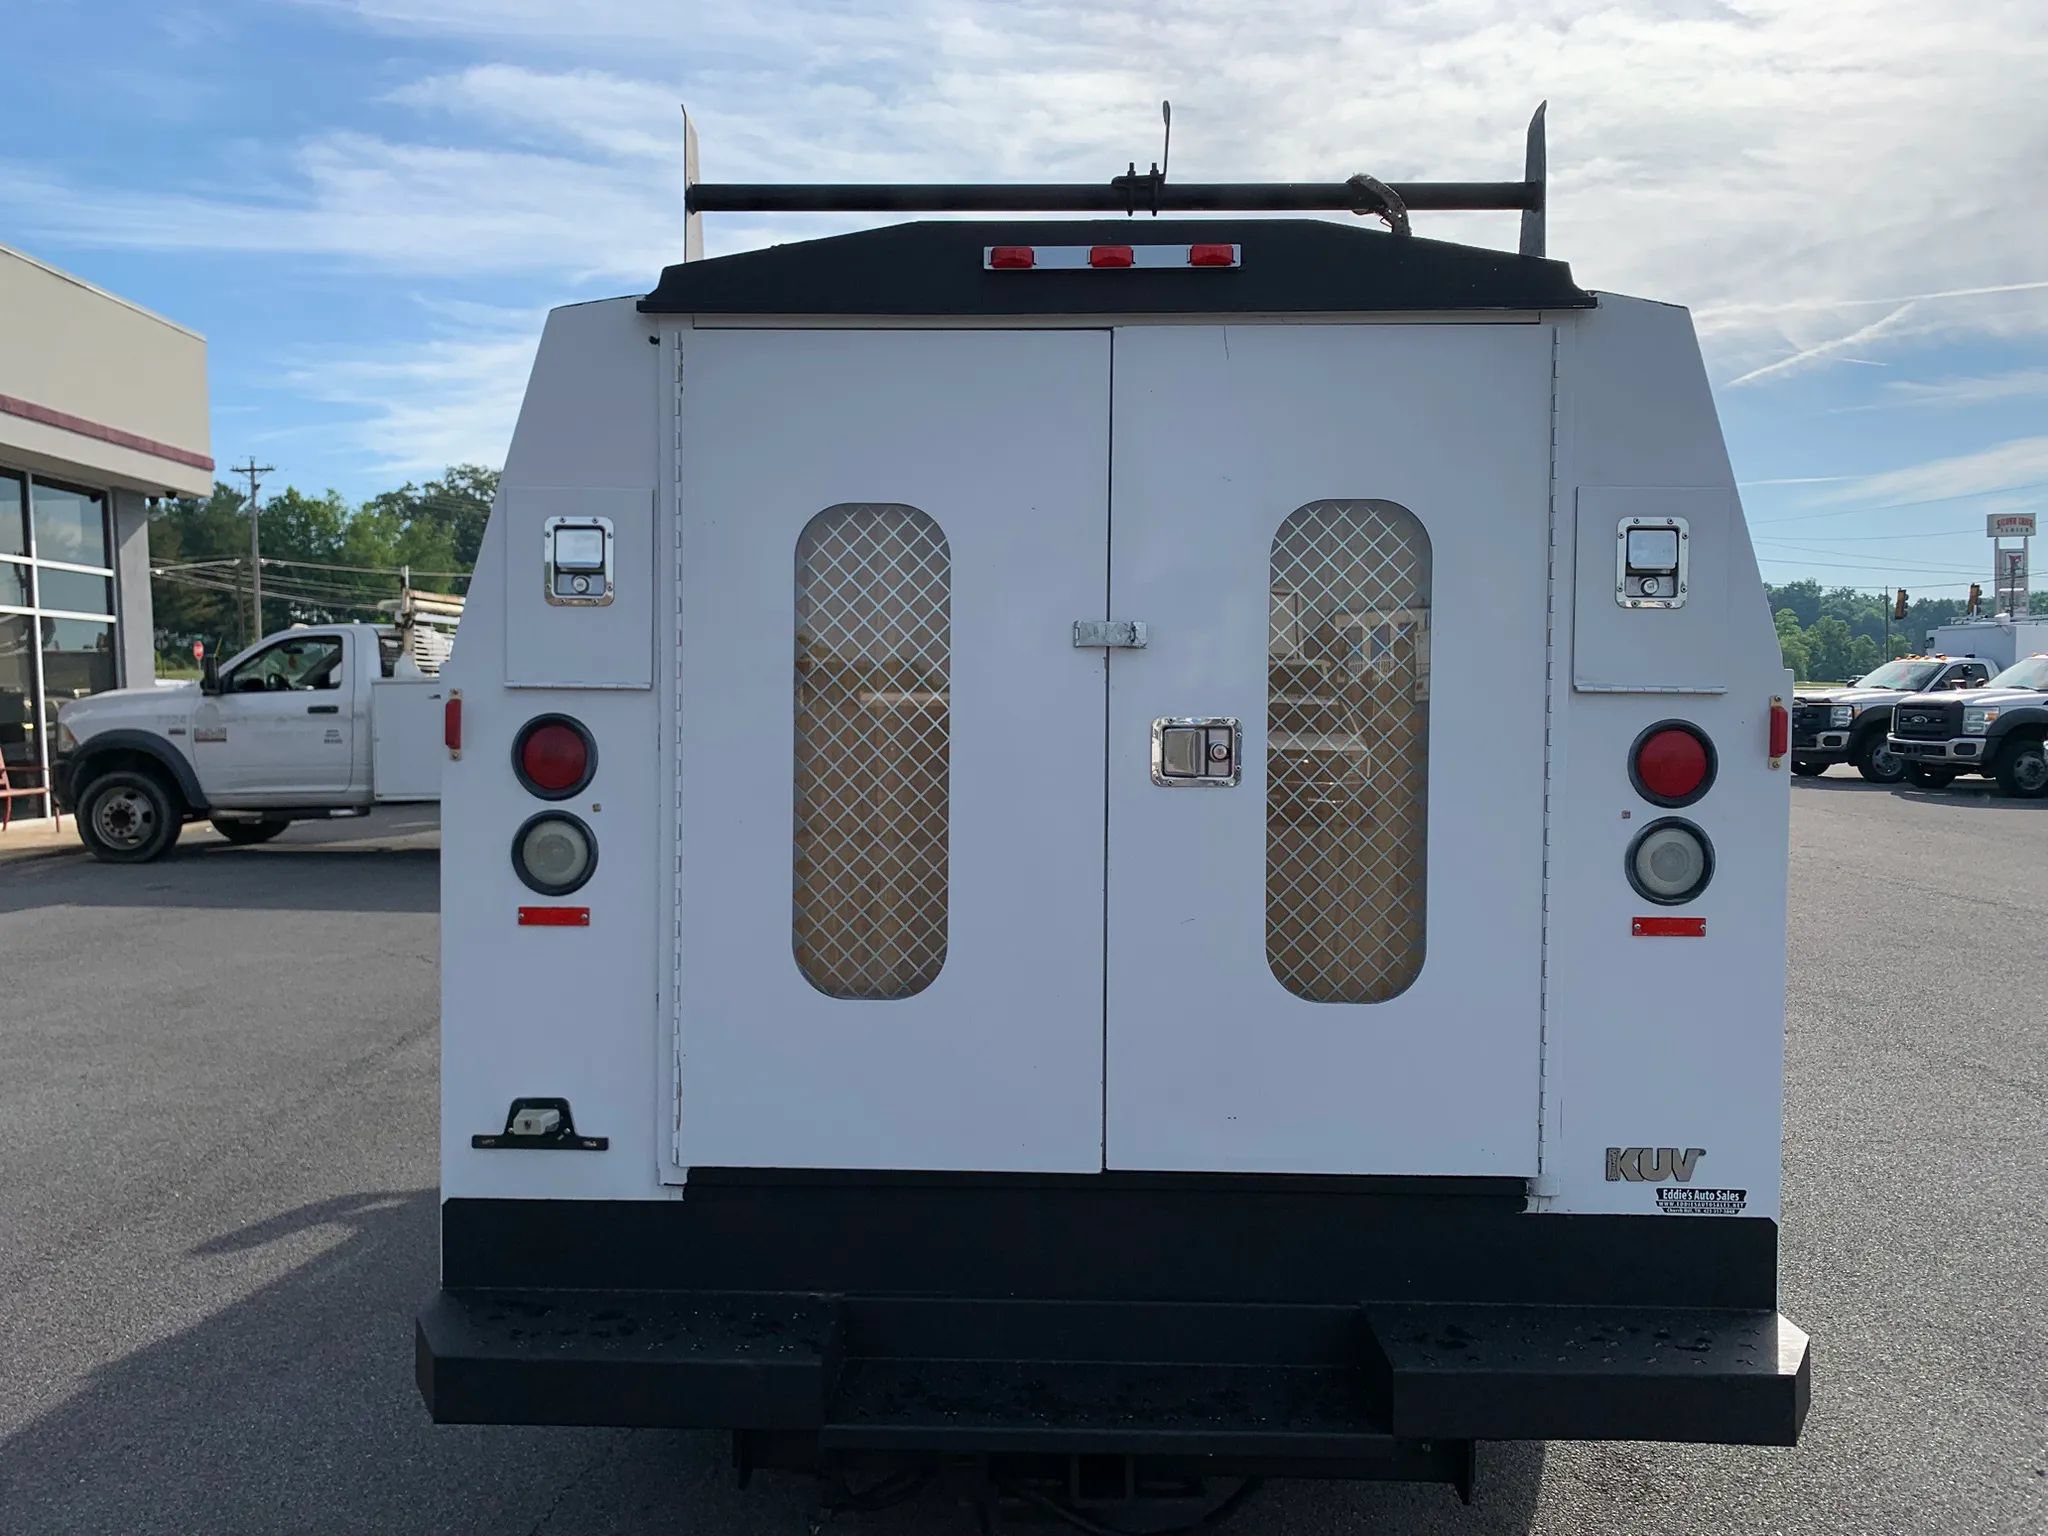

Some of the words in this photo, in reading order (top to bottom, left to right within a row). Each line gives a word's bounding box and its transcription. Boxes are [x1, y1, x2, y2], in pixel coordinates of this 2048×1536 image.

[1606, 1147, 1707, 1182] KUV
[1663, 1189, 1693, 1200] Eddie's
[1694, 1189, 1715, 1201] Auto
[1716, 1189, 1740, 1202] Sales
